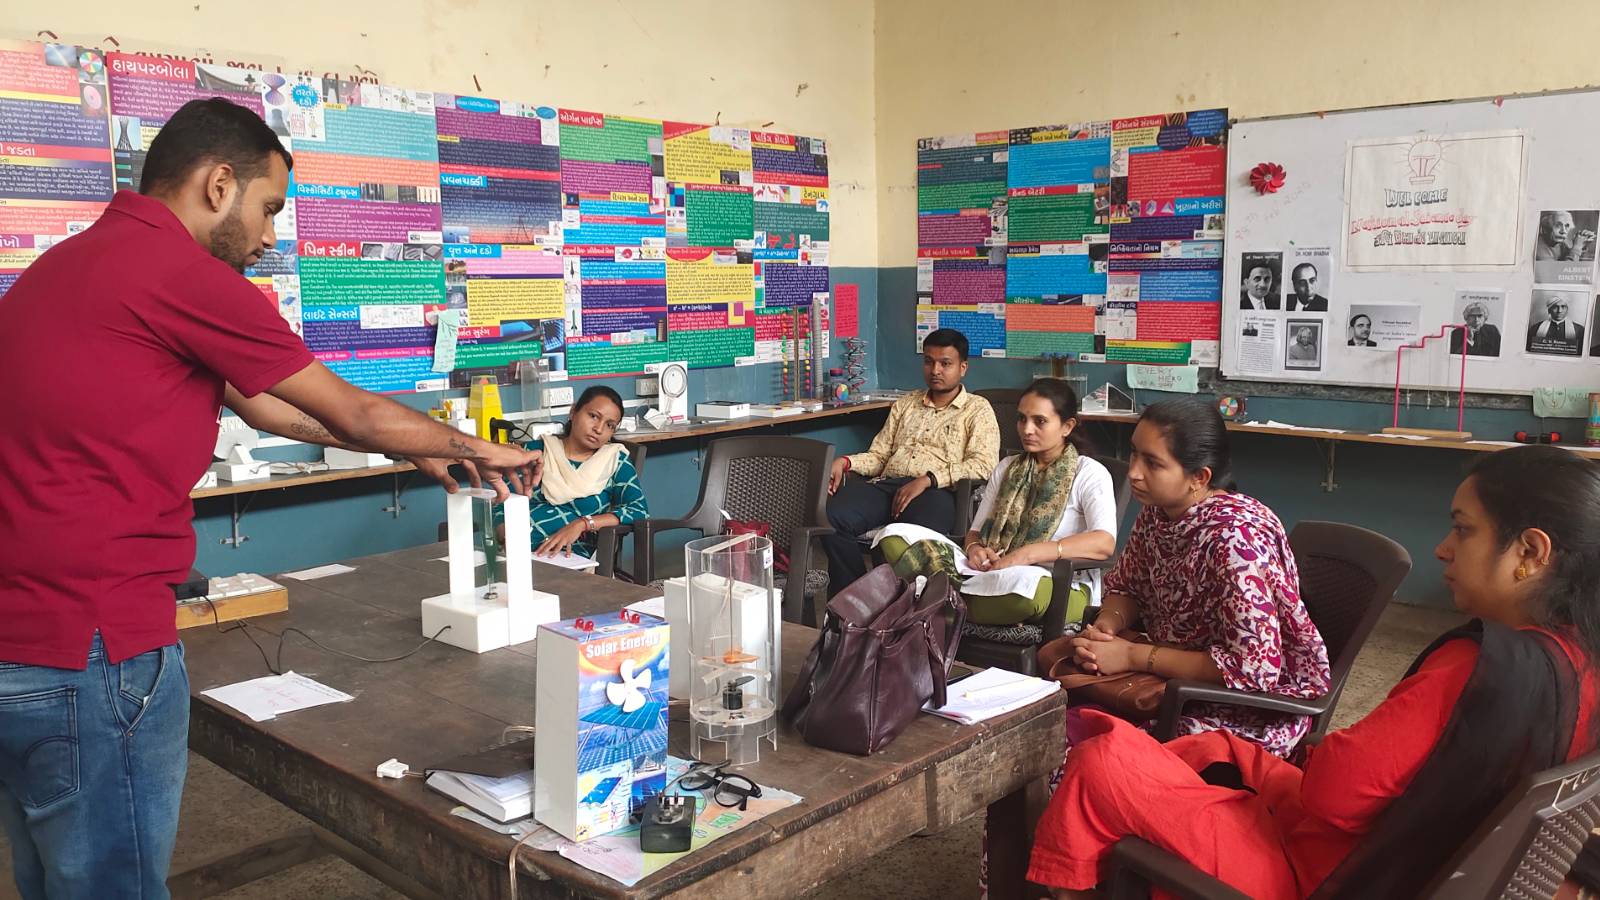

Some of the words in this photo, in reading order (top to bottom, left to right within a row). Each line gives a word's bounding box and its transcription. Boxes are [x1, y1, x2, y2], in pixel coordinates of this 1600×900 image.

[112, 57, 189, 80] હાયપરબોલા
[304, 242, 327, 257] પિન
[586, 640, 618, 658] Solar
[620, 633, 661, 649] Energy
